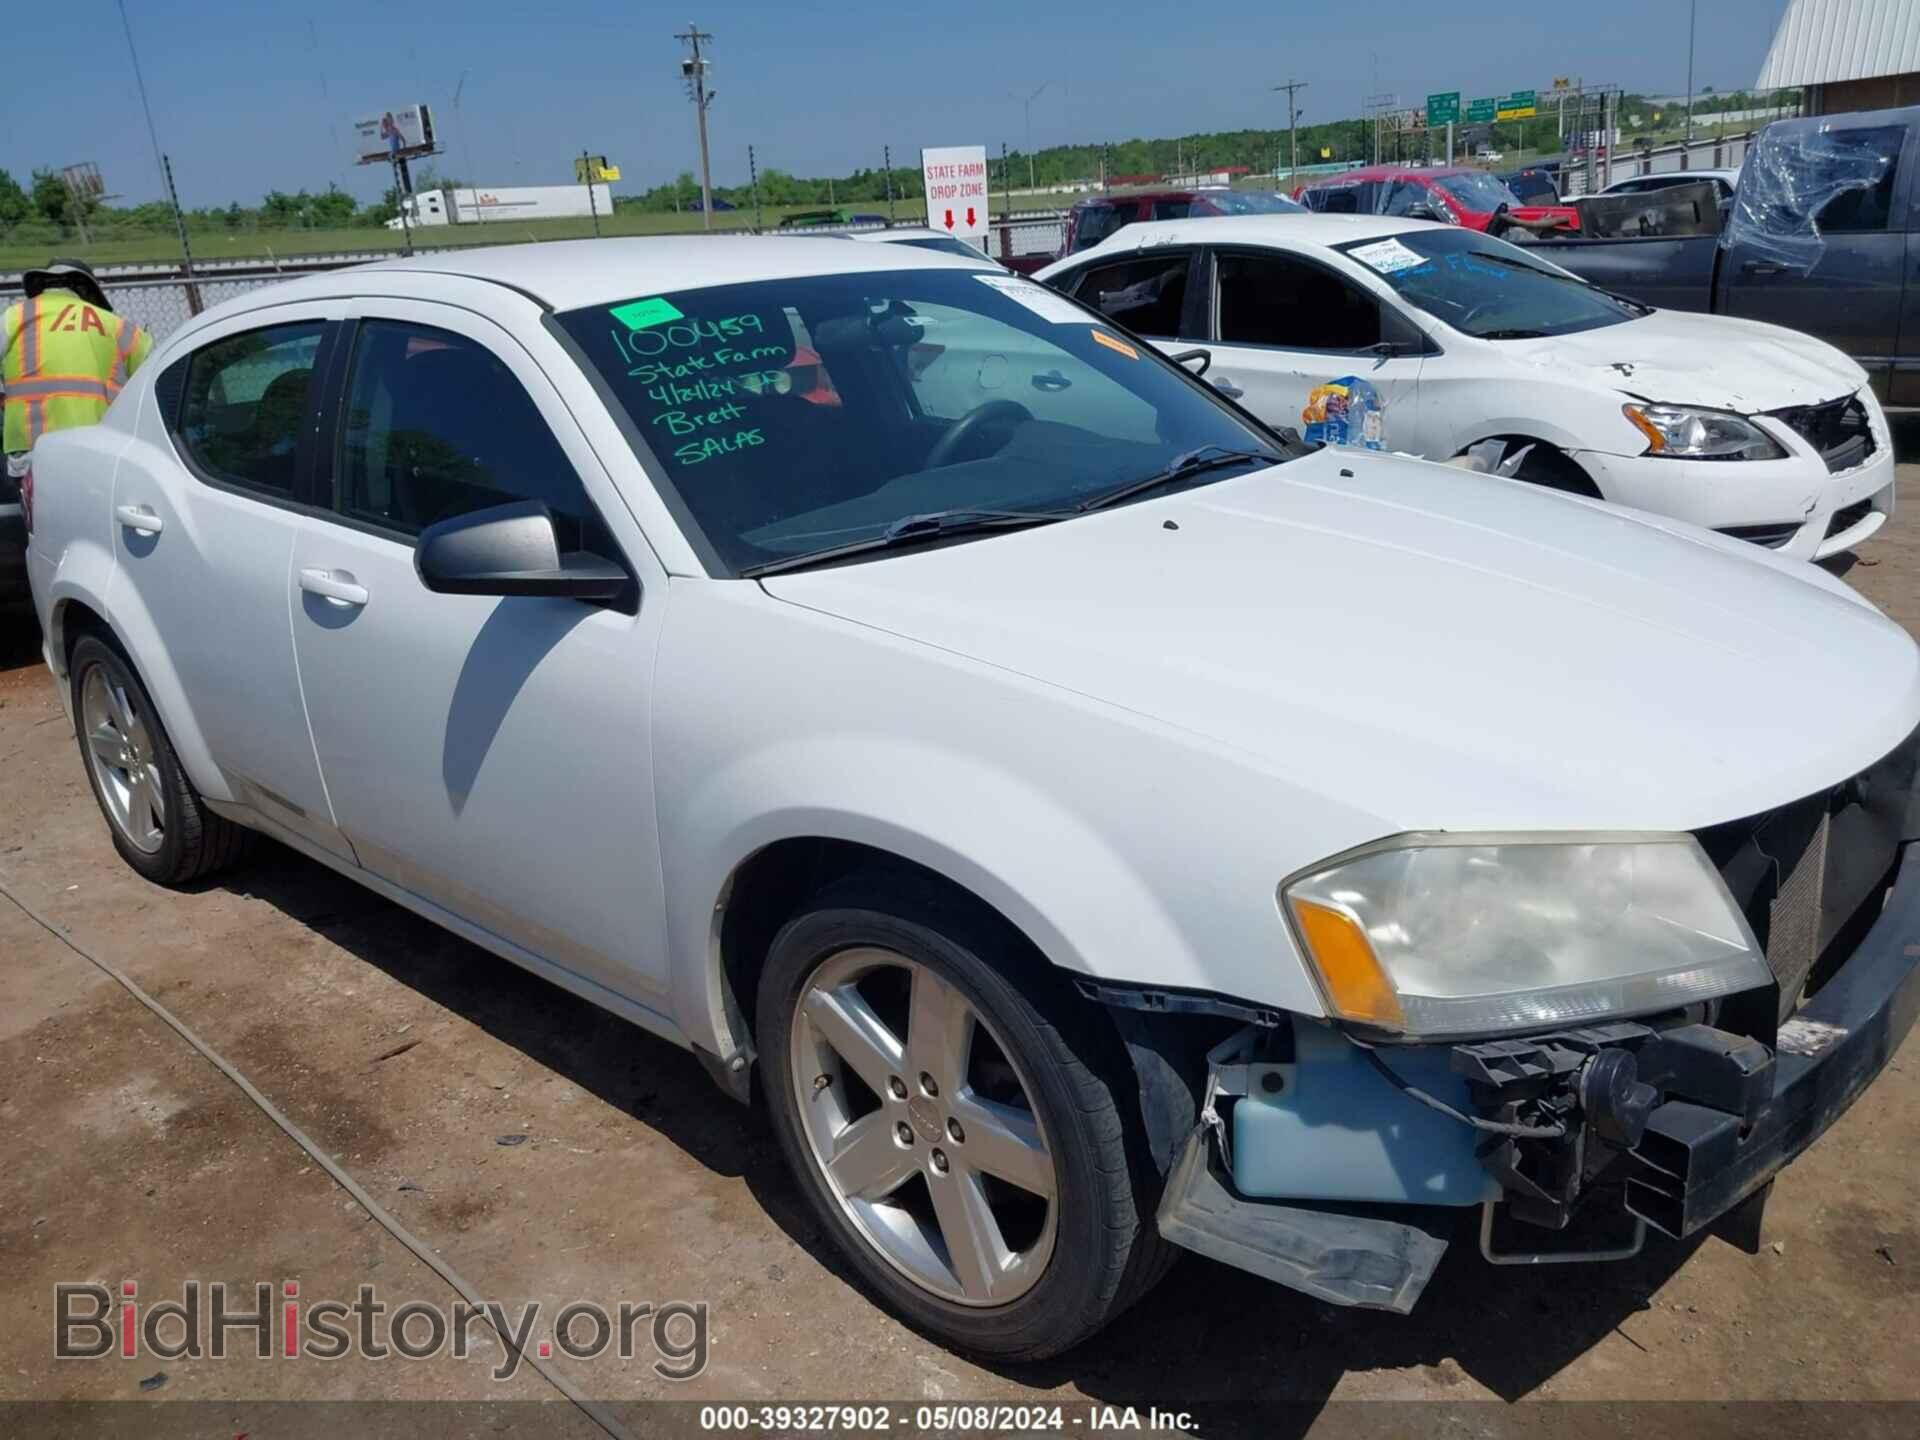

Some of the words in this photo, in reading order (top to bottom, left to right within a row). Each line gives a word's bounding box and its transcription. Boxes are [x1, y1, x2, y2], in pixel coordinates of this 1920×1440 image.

[927, 165, 956, 180] STATE
[958, 163, 984, 177] FARM
[930, 185, 957, 200] DROP
[960, 182, 984, 197] ZONE
[611, 313, 764, 365] 100459
[714, 345, 788, 365] Farm
[652, 402, 747, 436] Brett
[674, 428, 766, 466] SALAS
